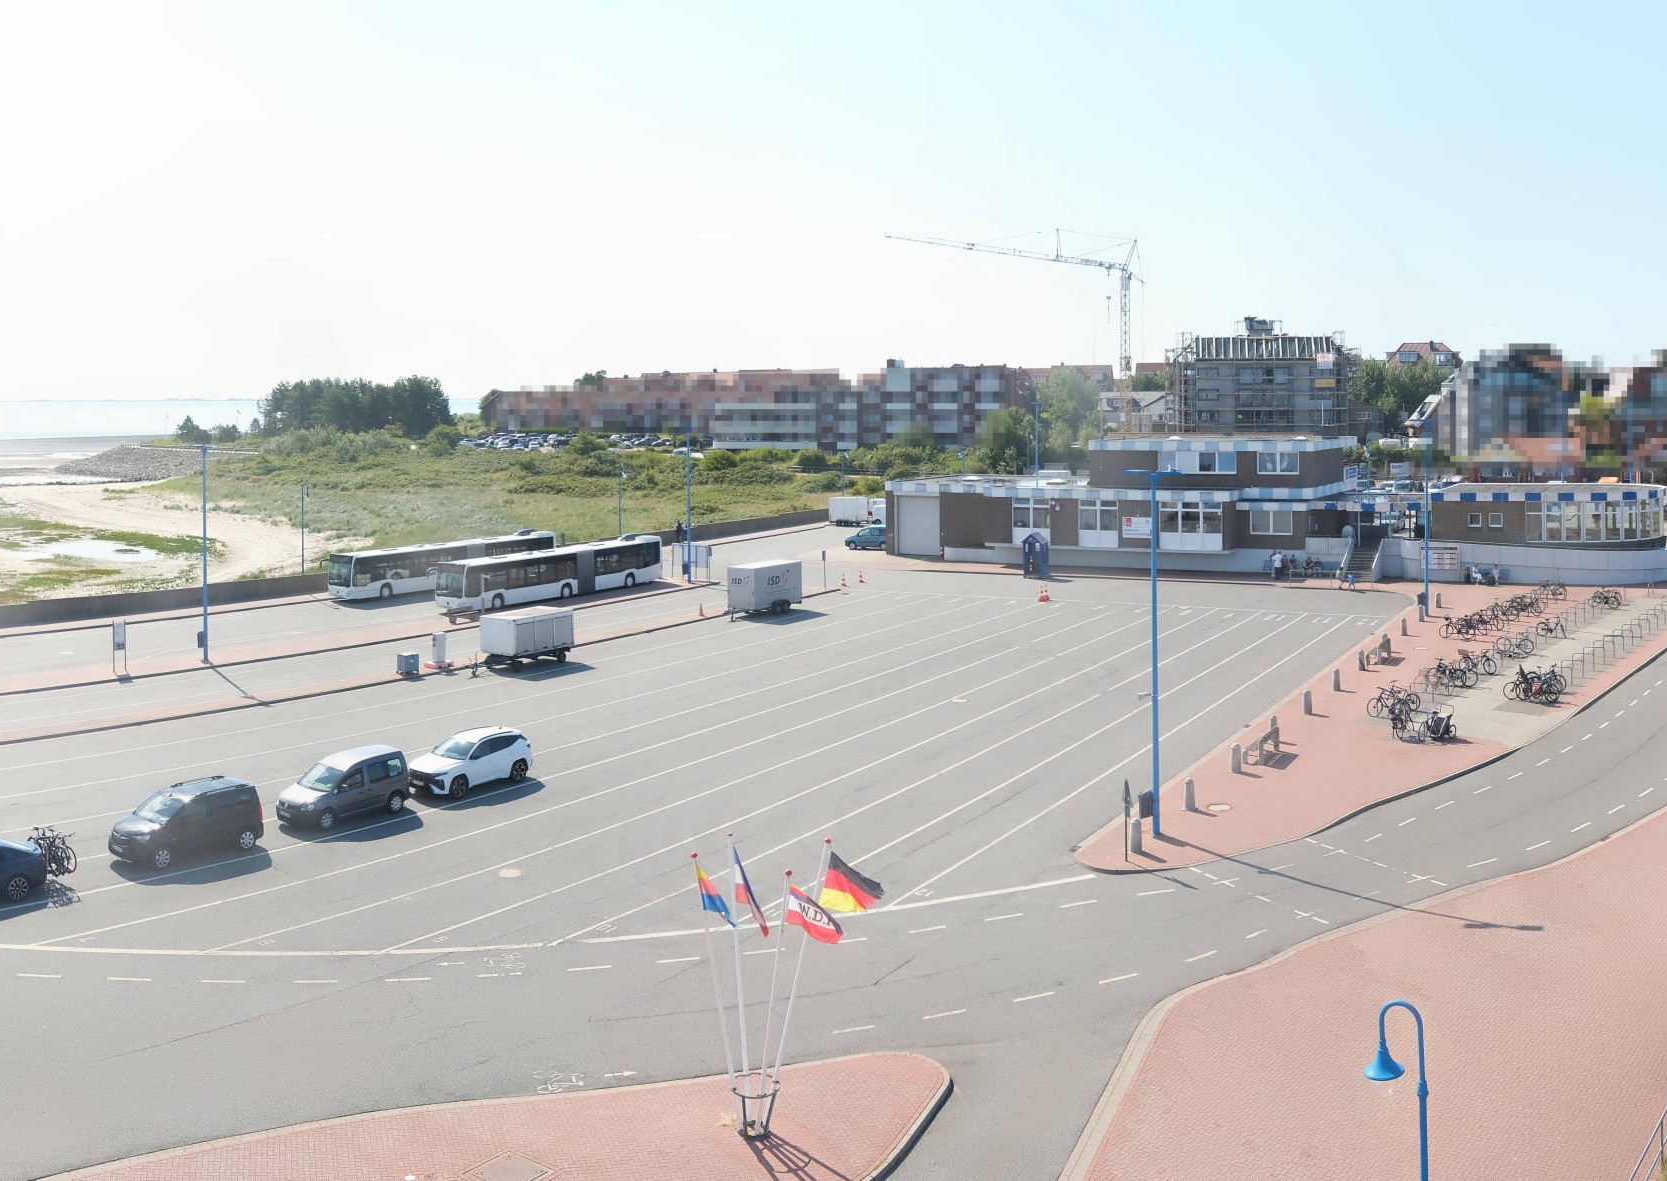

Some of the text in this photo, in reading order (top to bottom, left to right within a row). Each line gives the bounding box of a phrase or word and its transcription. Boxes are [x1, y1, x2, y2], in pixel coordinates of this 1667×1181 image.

[731, 577, 743, 585] ISD
[767, 575, 781, 587] ISD
[914, 888, 934, 897] 12
